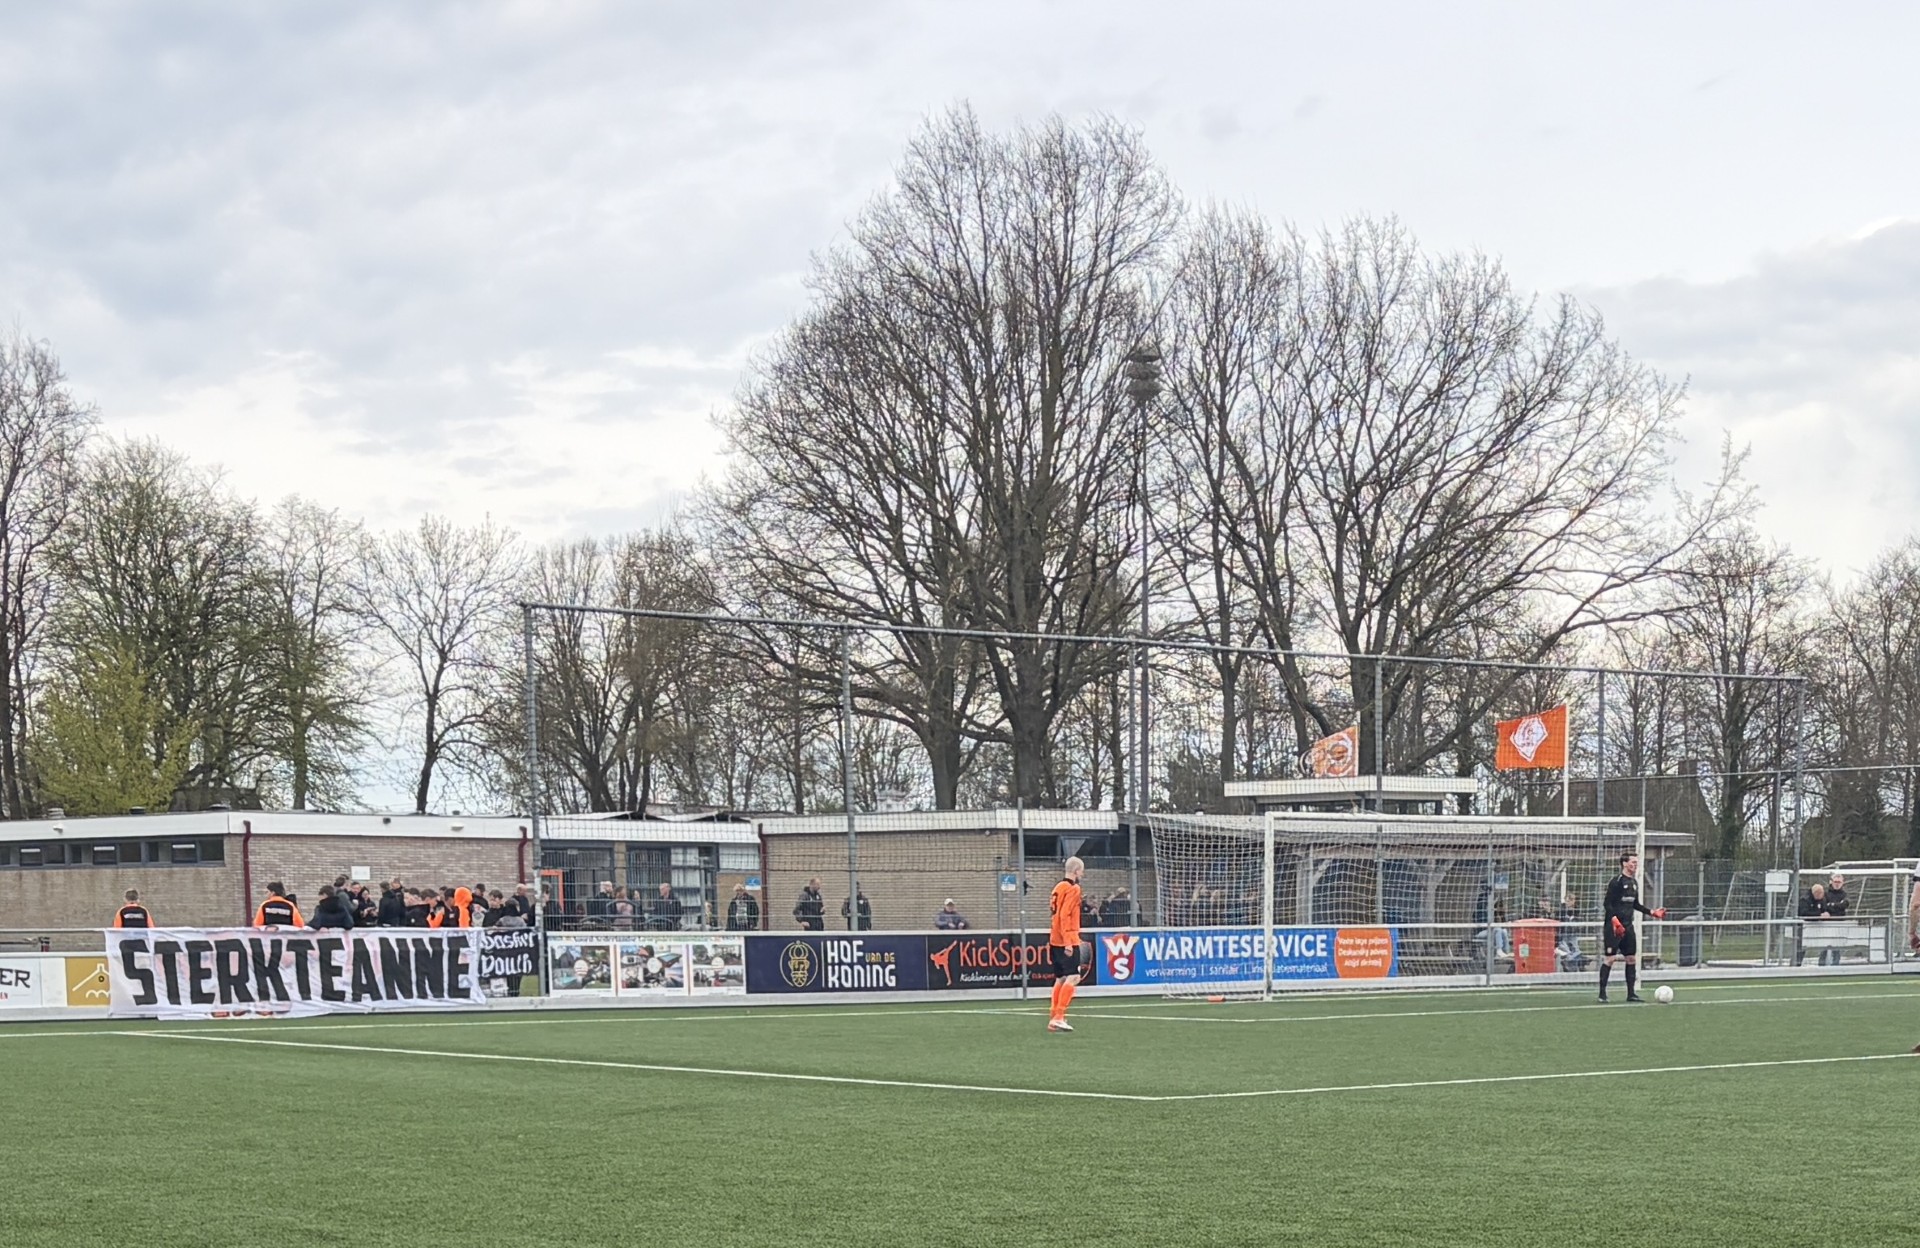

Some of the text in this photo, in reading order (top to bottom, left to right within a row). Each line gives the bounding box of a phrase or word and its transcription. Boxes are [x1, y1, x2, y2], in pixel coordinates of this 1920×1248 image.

[826, 940, 864, 963] HOF
[959, 938, 1053, 973] KickSport
[1143, 934, 1328, 961] WARMTESERVICE
[828, 964, 896, 988] KONING
